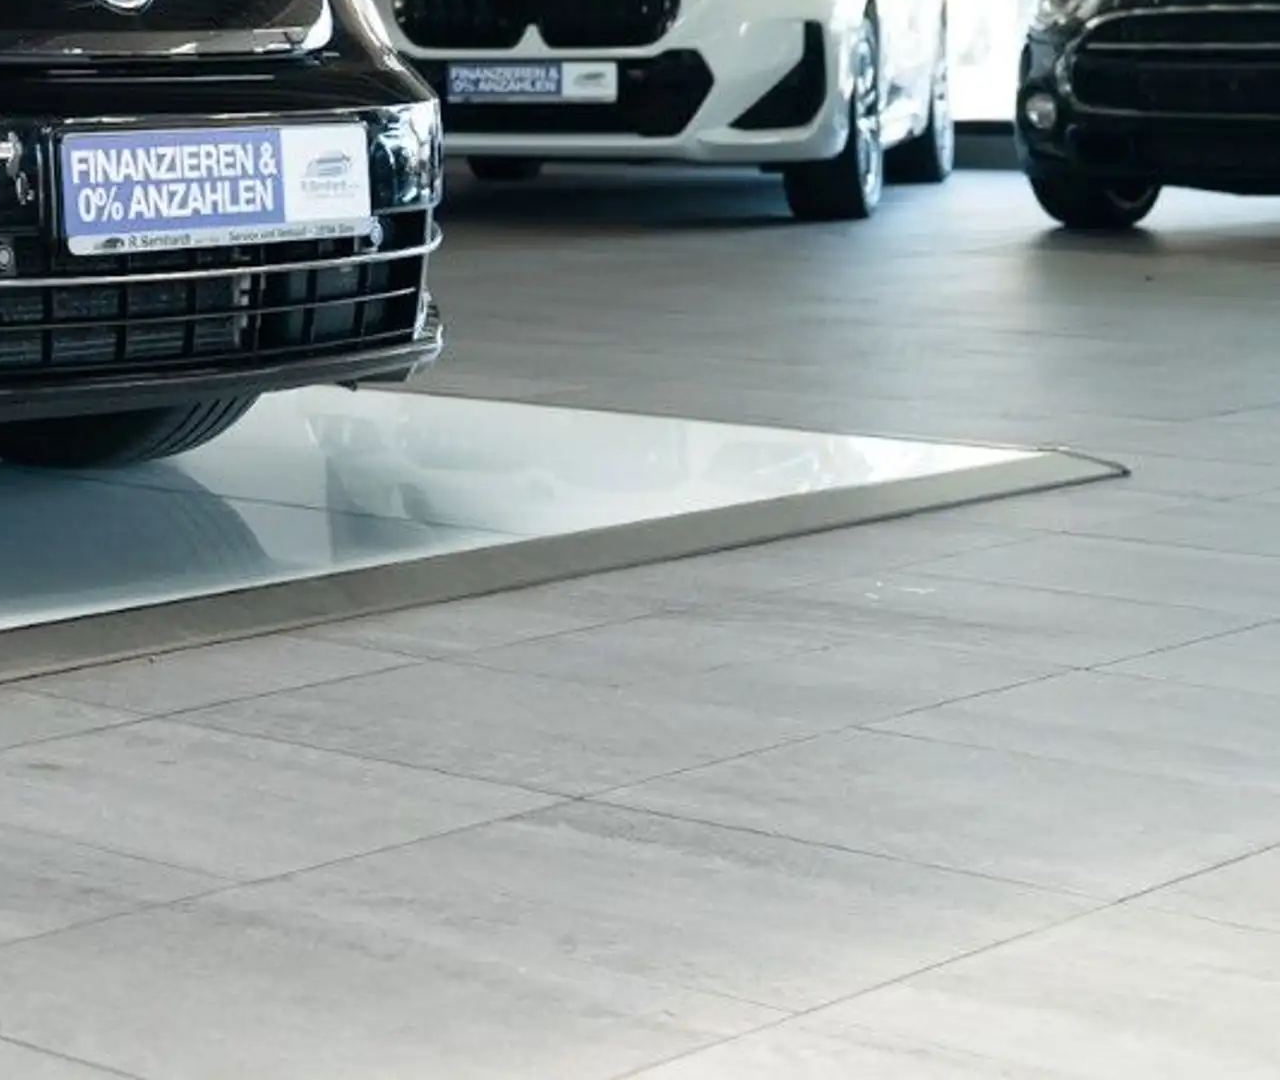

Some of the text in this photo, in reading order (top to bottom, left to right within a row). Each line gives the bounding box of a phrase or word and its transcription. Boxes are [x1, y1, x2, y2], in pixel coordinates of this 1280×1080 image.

[71, 141, 278, 184] FINANZIEREN &
[78, 178, 274, 223] 0% ANZAHLEN
